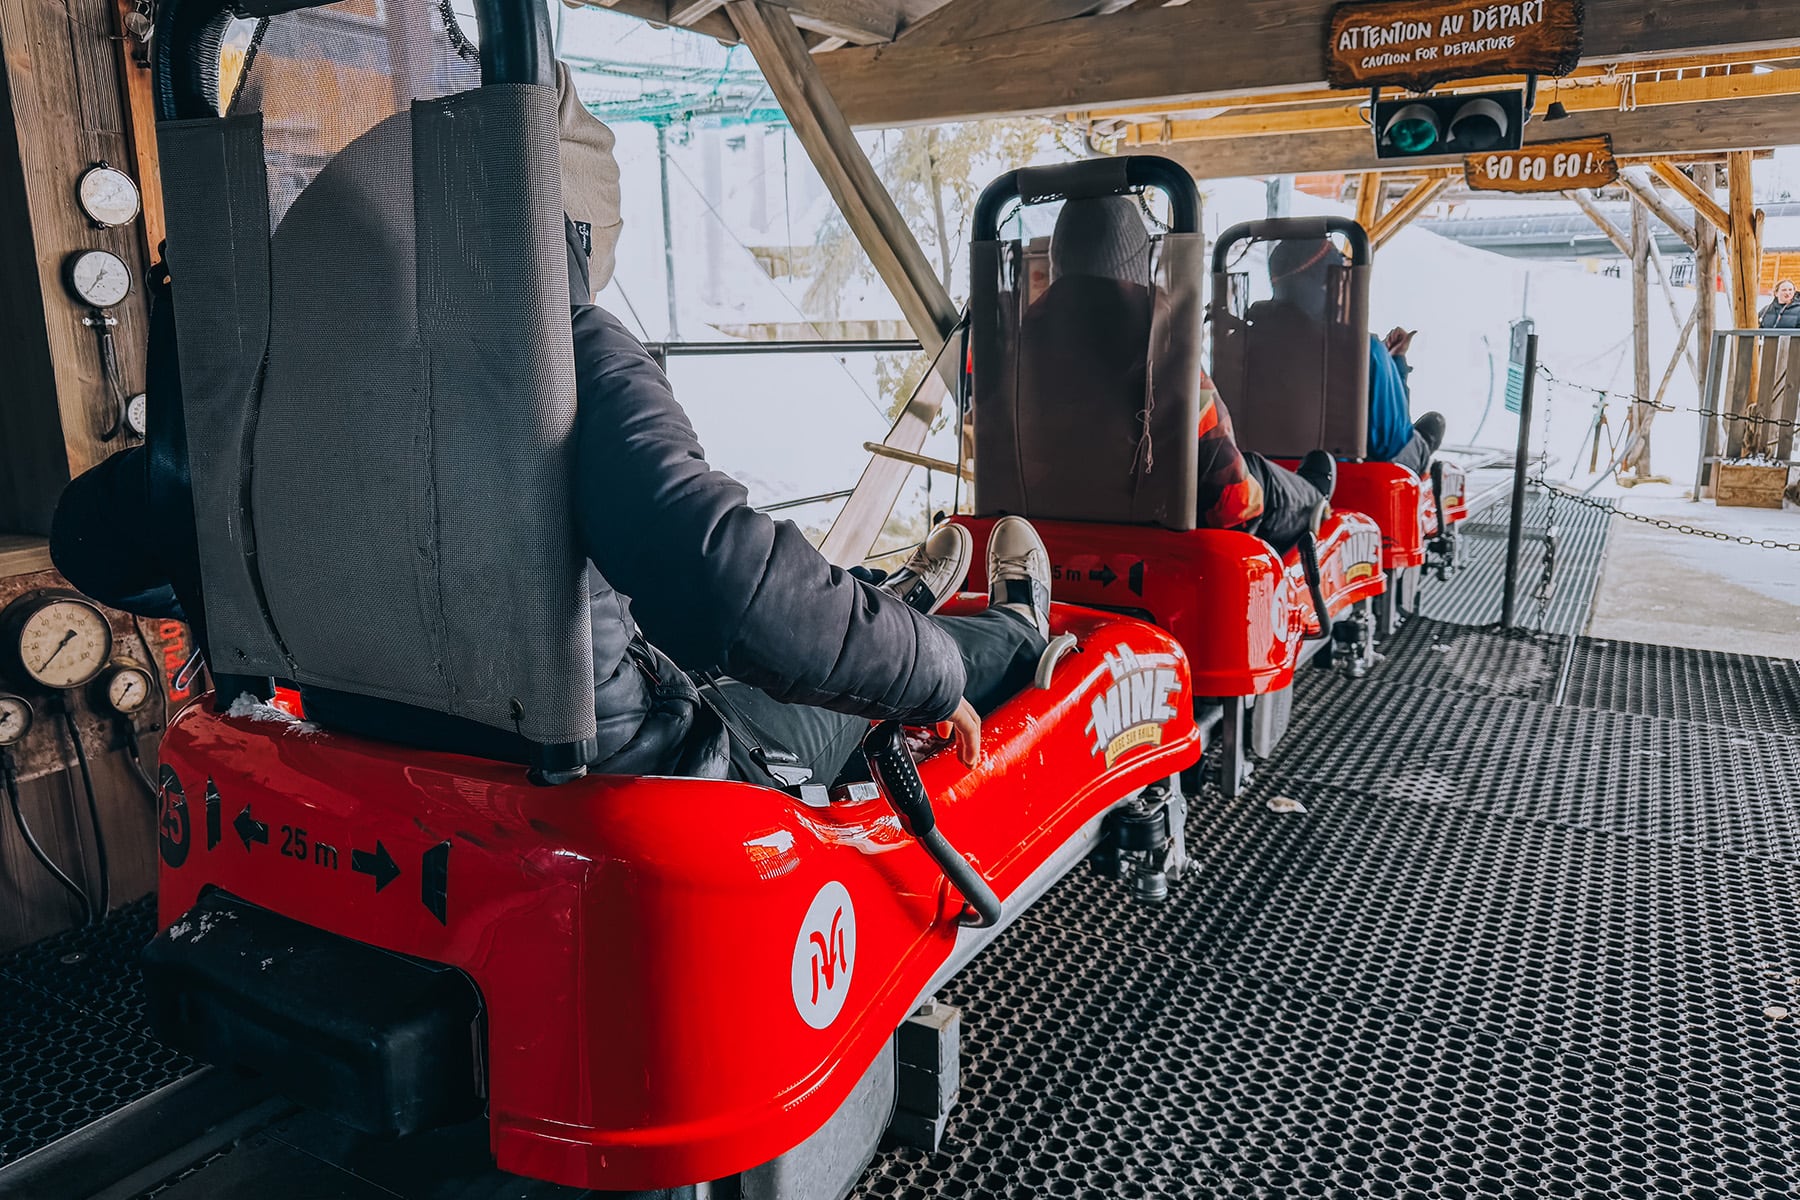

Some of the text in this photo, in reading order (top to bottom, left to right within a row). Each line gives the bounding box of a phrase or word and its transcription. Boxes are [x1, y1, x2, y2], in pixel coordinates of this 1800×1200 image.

[1339, 0, 1545, 51] ATTENTION AU DÉPART
[1361, 36, 1516, 69] CAUTION FOR DEPARTURE
[1485, 155, 1513, 180] GO
[1518, 156, 1546, 181] GO
[1052, 565, 1081, 581] 5 m
[1104, 642, 1140, 681] LA
[1087, 668, 1182, 752] MINE
[280, 825, 338, 870] 25 m
